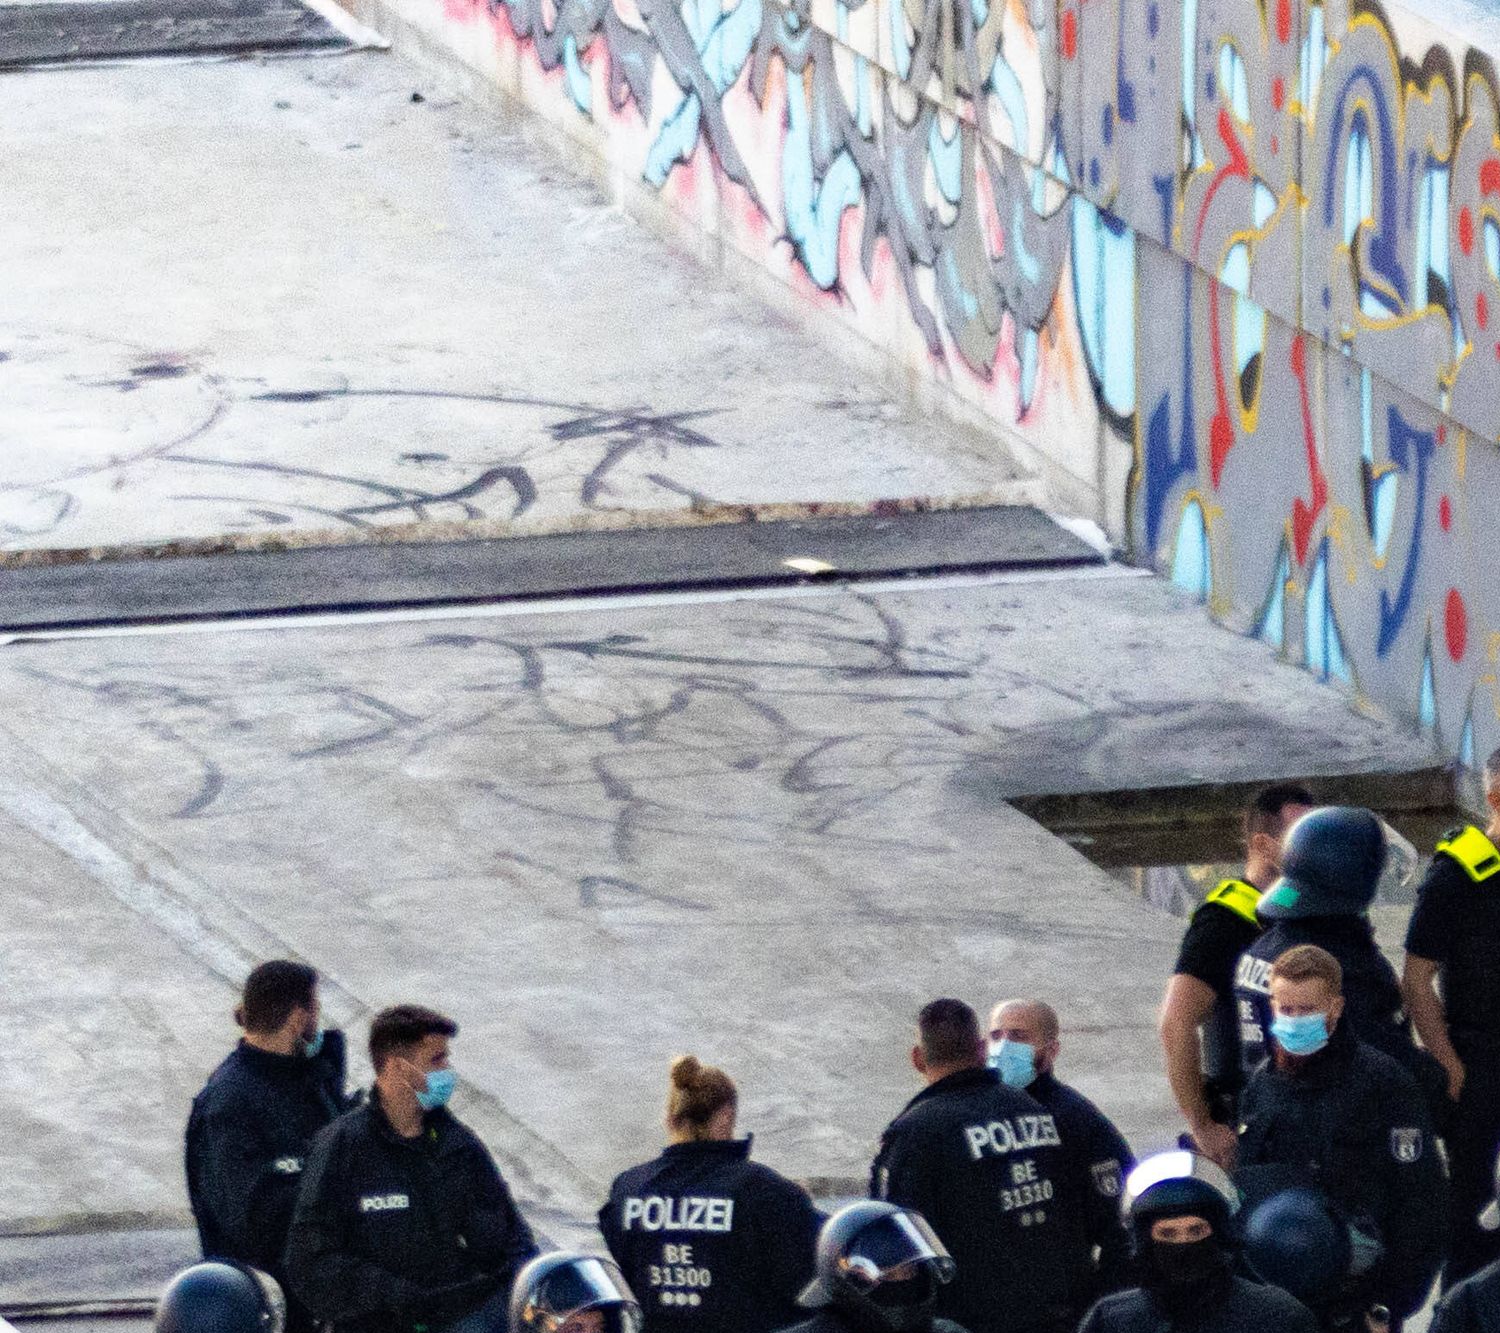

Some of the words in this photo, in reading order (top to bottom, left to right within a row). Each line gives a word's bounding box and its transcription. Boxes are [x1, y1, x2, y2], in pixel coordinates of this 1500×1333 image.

[965, 1114, 1063, 1160] POLIZEI
[1011, 1160, 1038, 1184] BE
[622, 1196, 735, 1232] POLIZEI
[663, 1243, 693, 1264] BE
[650, 1266, 711, 1287] 31300
